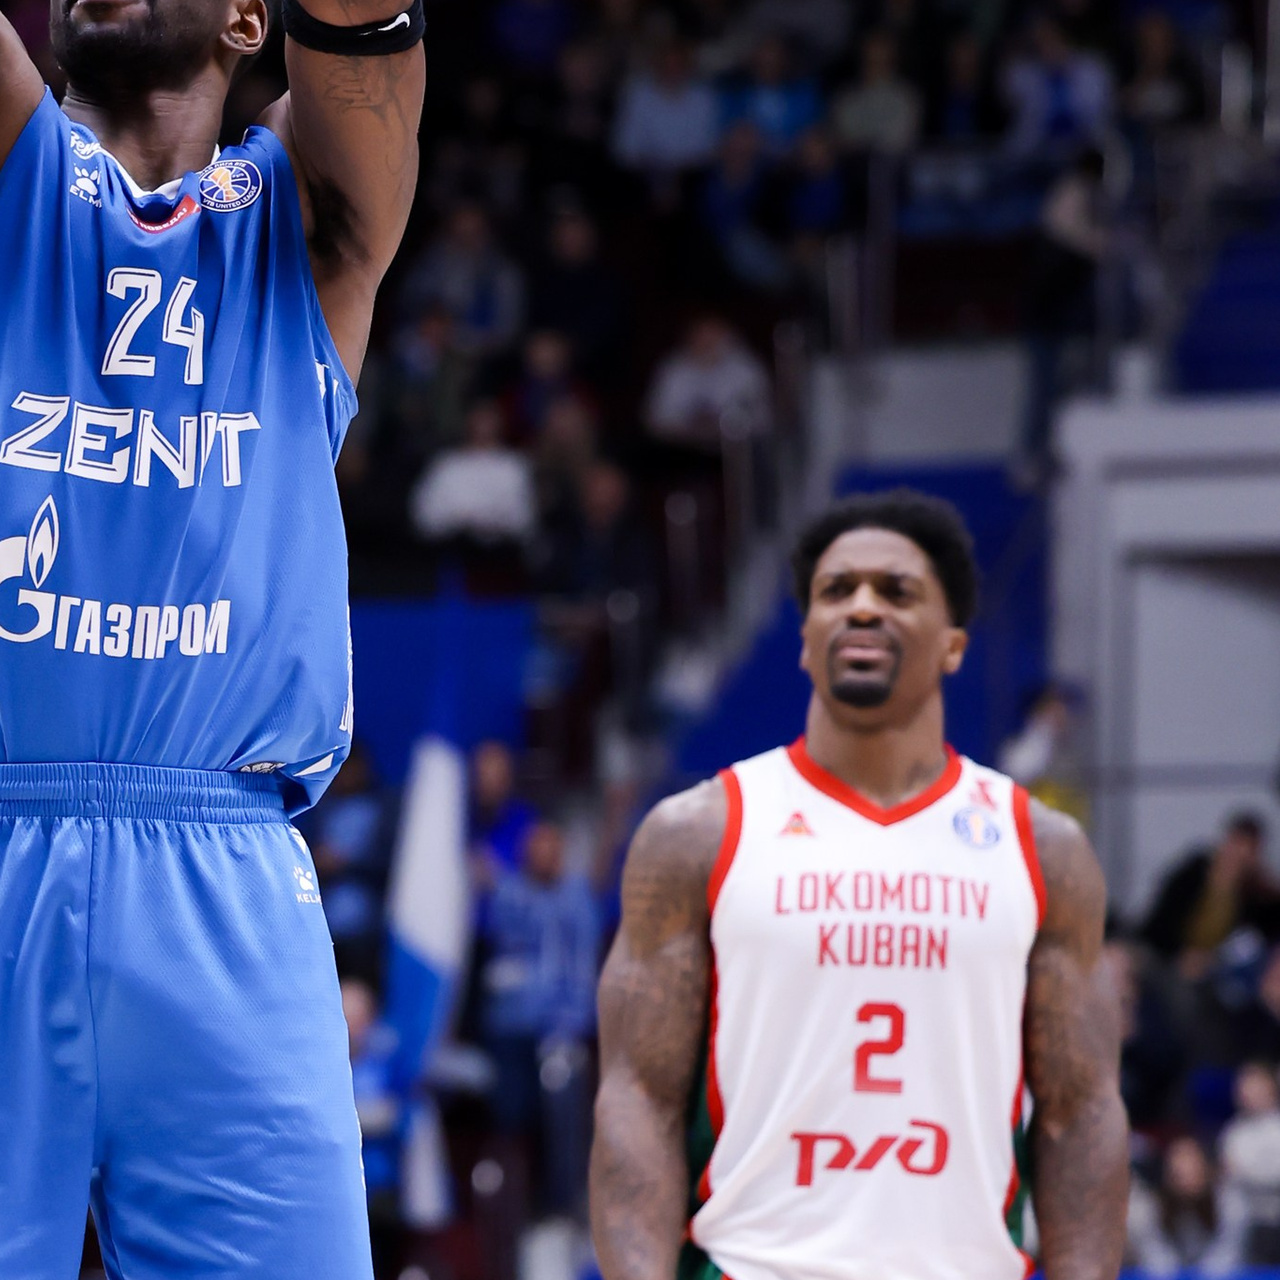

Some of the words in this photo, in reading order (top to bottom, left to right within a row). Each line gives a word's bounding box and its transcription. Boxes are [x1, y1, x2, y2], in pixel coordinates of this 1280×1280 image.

[215, 201, 242, 209] UNITED
[101, 267, 205, 385] 24
[54, 596, 231, 660] ГАЗПРОМ
[296, 893, 323, 905] KELM
[775, 871, 989, 920] LOKOMOTIV
[817, 923, 948, 969] KUBAN
[853, 1001, 906, 1094] 2
